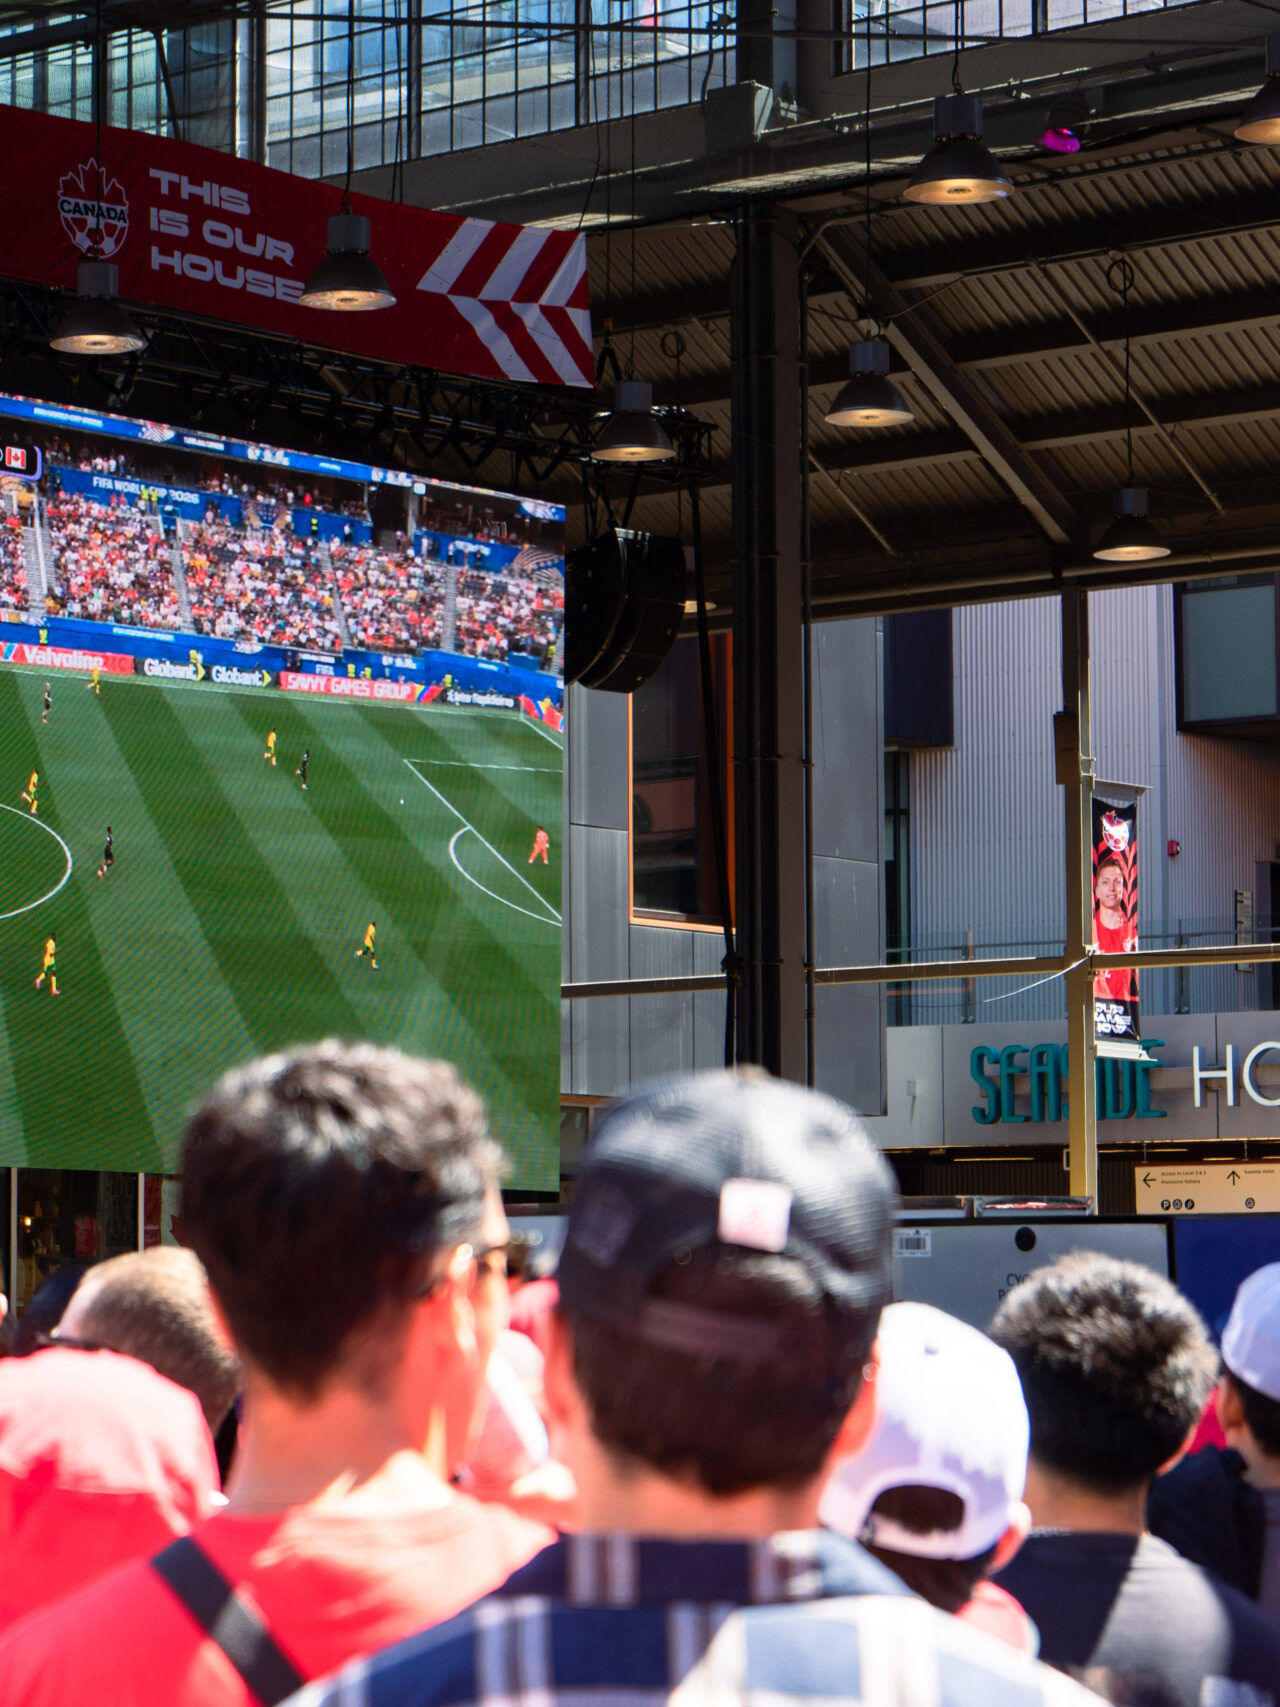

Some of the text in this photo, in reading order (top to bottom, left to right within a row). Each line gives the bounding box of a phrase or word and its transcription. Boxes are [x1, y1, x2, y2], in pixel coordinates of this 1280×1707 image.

[149, 168, 251, 215] THIS
[59, 198, 128, 224] CANADA
[150, 207, 294, 267] IS OUR
[151, 246, 306, 306] HOUSE
[93, 476, 114, 490] FIFA
[23, 644, 104, 671] Valvoline
[144, 658, 197, 680] Globant
[212, 665, 263, 687] Globant
[1095, 1012, 1132, 1026] AME
[971, 1039, 1167, 1125] SEAIDE
